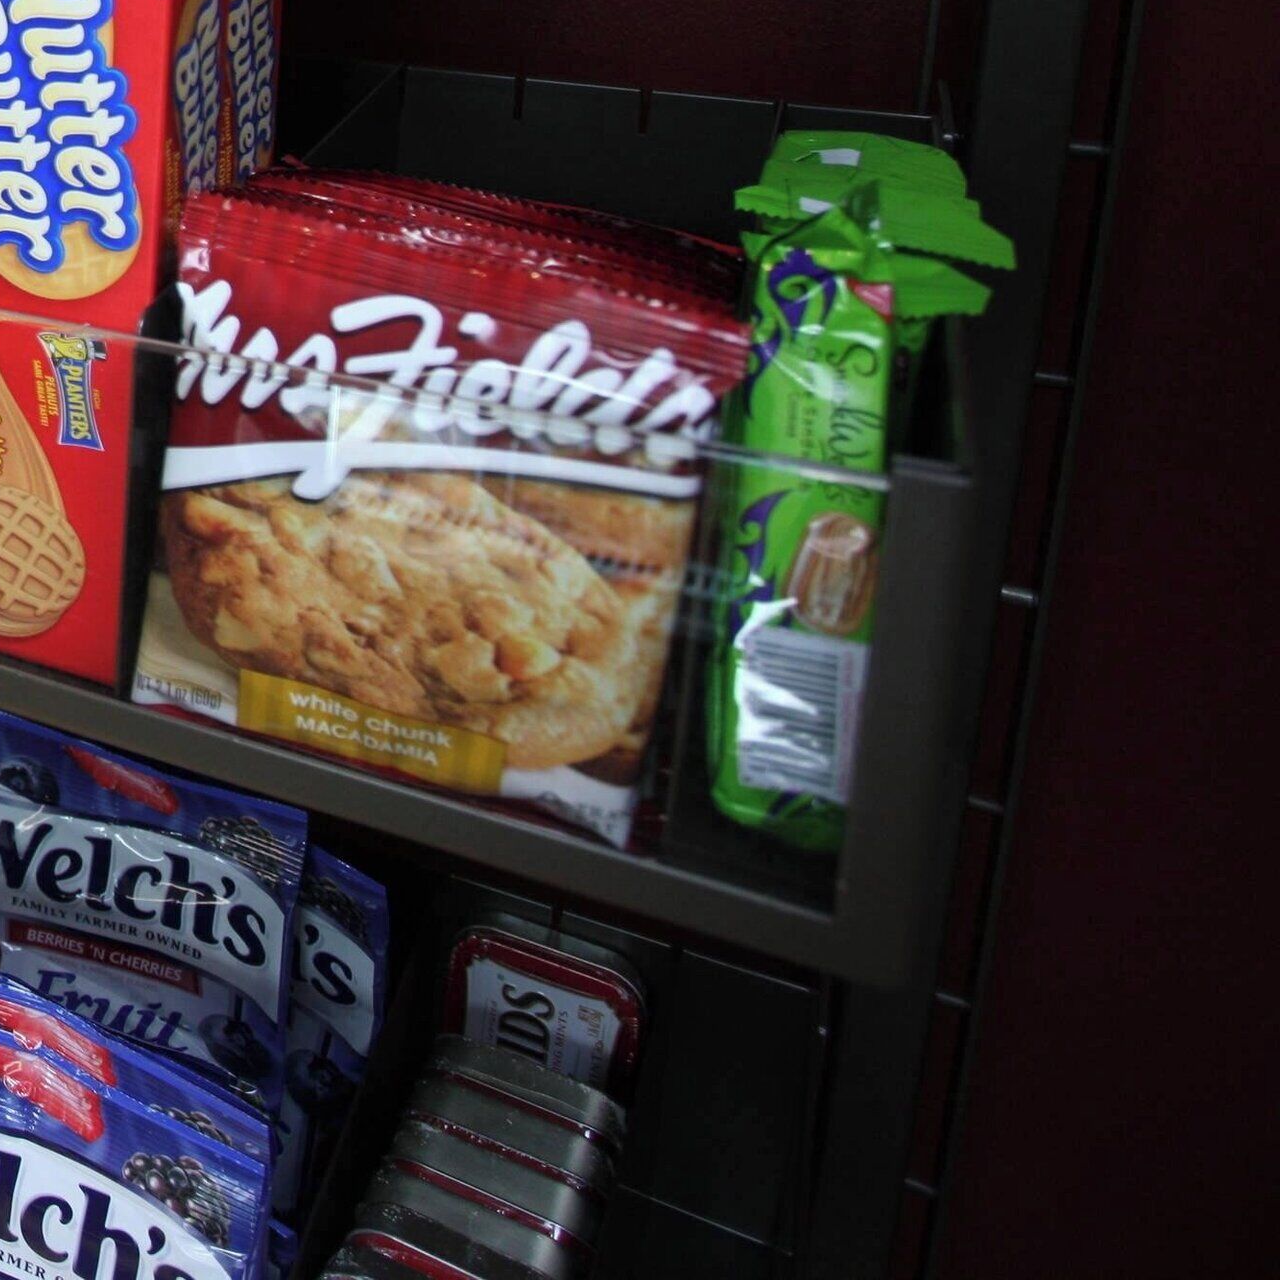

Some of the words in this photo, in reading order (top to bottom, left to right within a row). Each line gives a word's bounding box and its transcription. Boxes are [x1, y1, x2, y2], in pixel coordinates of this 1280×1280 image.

[175, 37, 204, 195] Butte
[45, 375, 60, 417] PEANUTS
[62, 363, 92, 440] PLANTERS
[288, 688, 361, 725] white
[366, 714, 454, 750] chunk
[295, 713, 438, 767] MACADAMIA
[11, 895, 70, 919] FAMILY
[74, 911, 140, 938] FARMER
[144, 931, 203, 962] OWNED
[25, 928, 85, 957] BERRIES
[109, 950, 183, 983] CHERRIES
[36, 968, 188, 1051] Fruit
